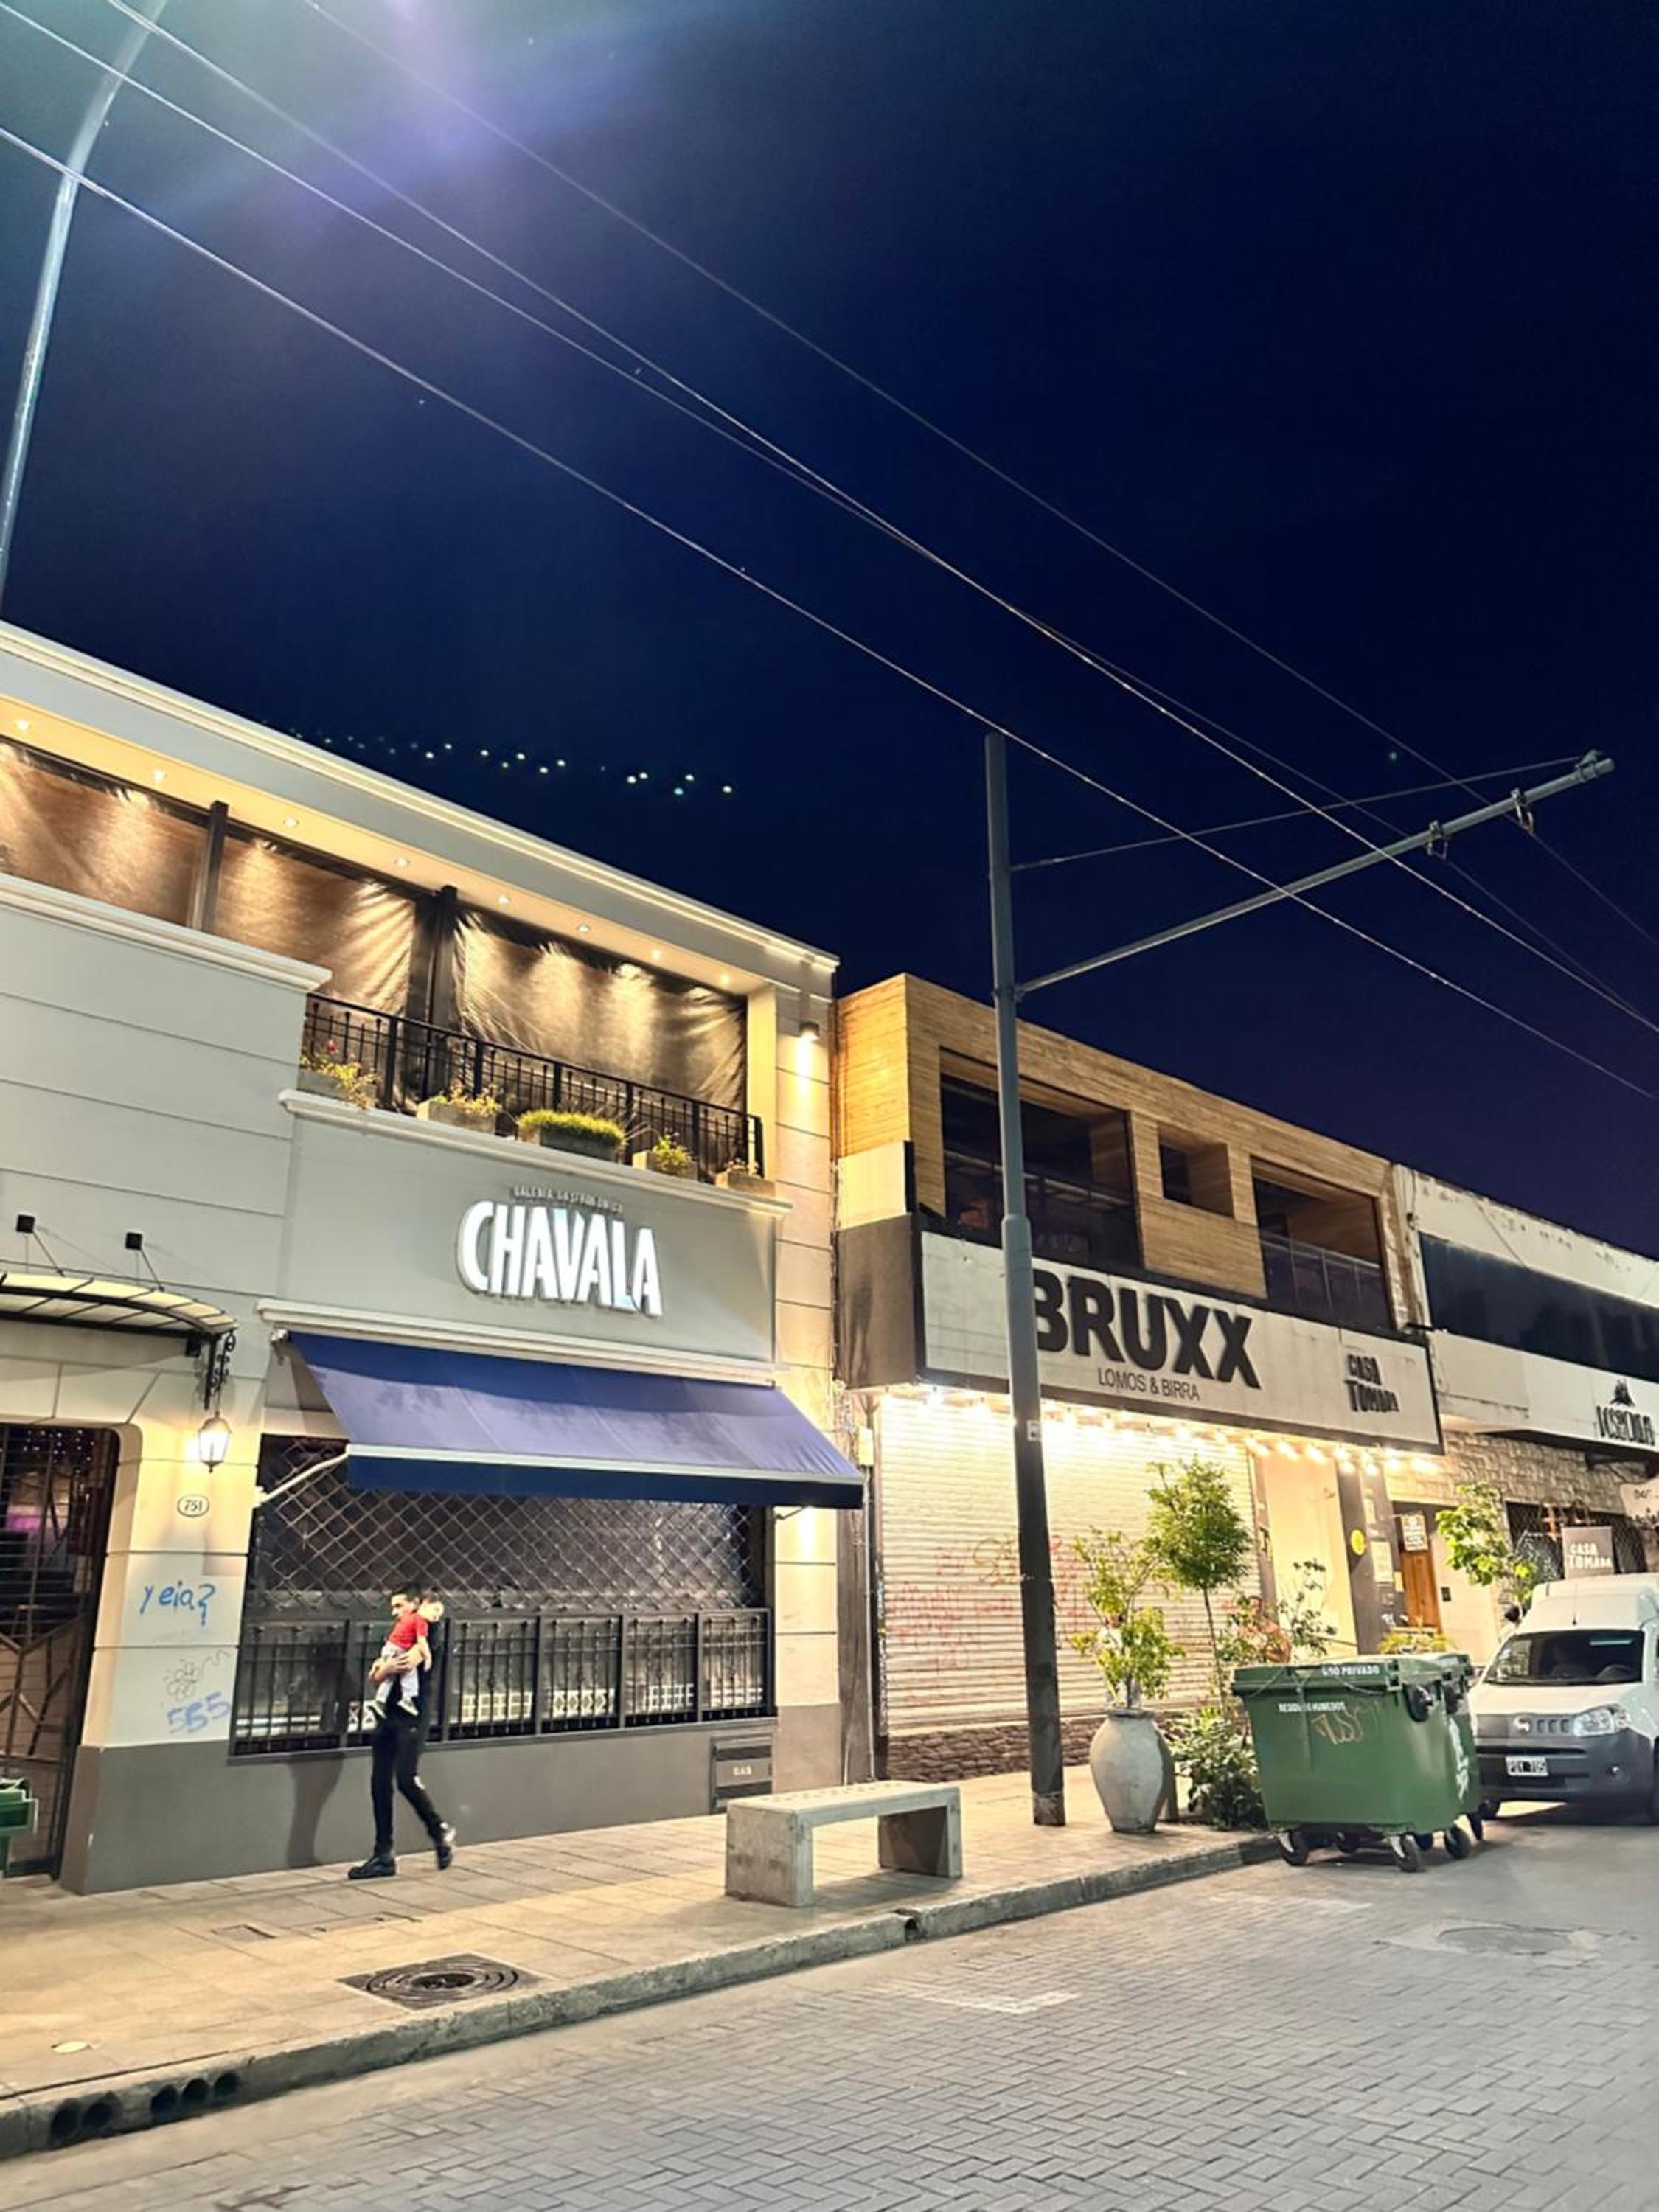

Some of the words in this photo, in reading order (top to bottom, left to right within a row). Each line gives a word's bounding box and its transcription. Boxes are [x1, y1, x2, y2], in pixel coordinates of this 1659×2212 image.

[457, 1200, 662, 1317] CHAVALA
[1033, 1268, 1260, 1390] BRUXX
[1098, 1368, 1147, 1392] LOMOS
[1150, 1376, 1160, 1394] &
[1162, 1378, 1200, 1401] BIRRA
[1347, 1354, 1381, 1386] CASA
[1569, 1542, 1598, 1555] CASA
